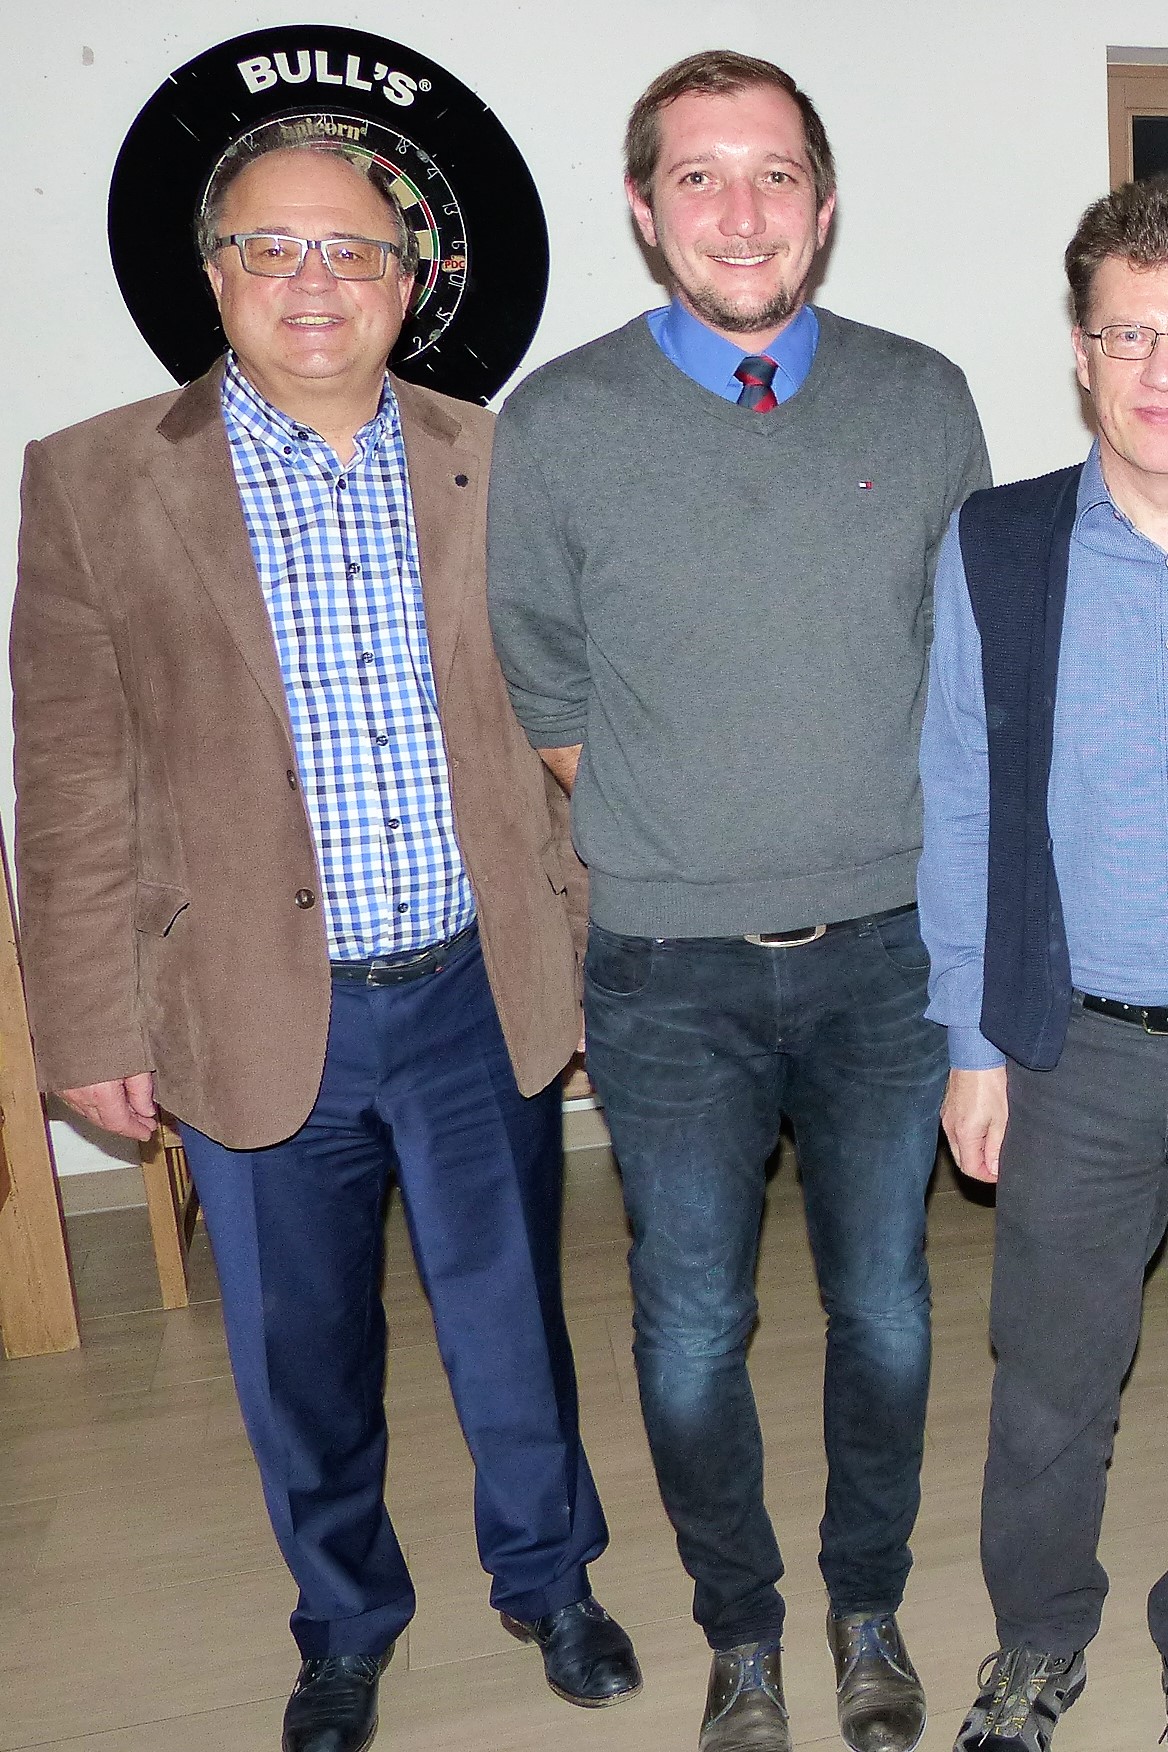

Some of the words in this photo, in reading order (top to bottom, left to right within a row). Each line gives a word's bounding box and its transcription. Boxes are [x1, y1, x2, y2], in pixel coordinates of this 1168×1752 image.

[395, 137, 410, 154] 18
[442, 202, 459, 215] 13
[444, 260, 465, 269] PDC
[448, 274, 466, 288] 10
[435, 307, 453, 326] 15
